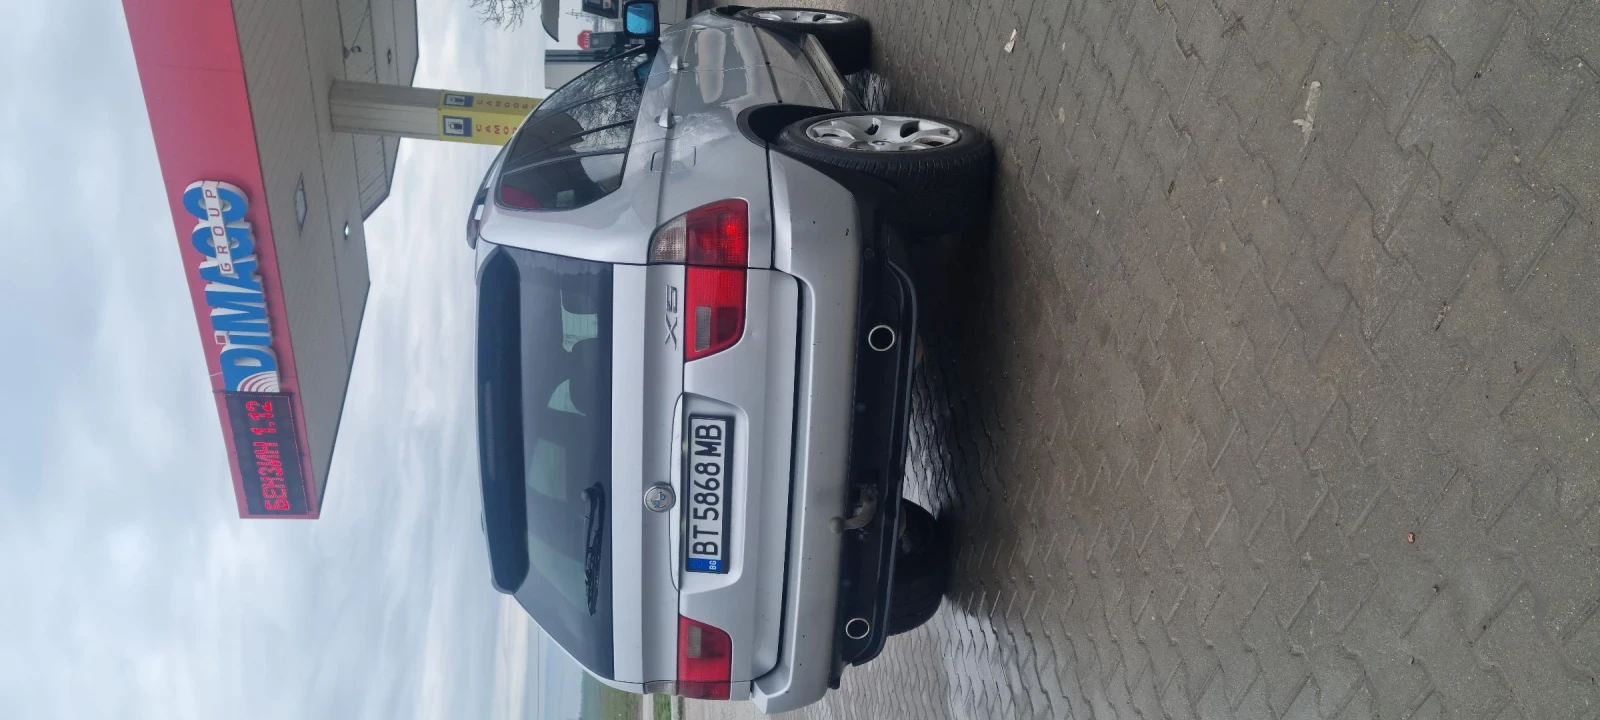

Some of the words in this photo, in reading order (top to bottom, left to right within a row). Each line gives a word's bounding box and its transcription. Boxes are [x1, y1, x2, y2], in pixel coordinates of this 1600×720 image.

[204, 188, 233, 273] GROUP
[664, 284, 678, 351] X5
[245, 400, 277, 436] 1.12
[695, 422, 722, 458] MB
[252, 441, 290, 511] БЕНЗИН
[693, 461, 721, 522] 5868
[692, 525, 719, 556] BT
[708, 559, 718, 570] BG
